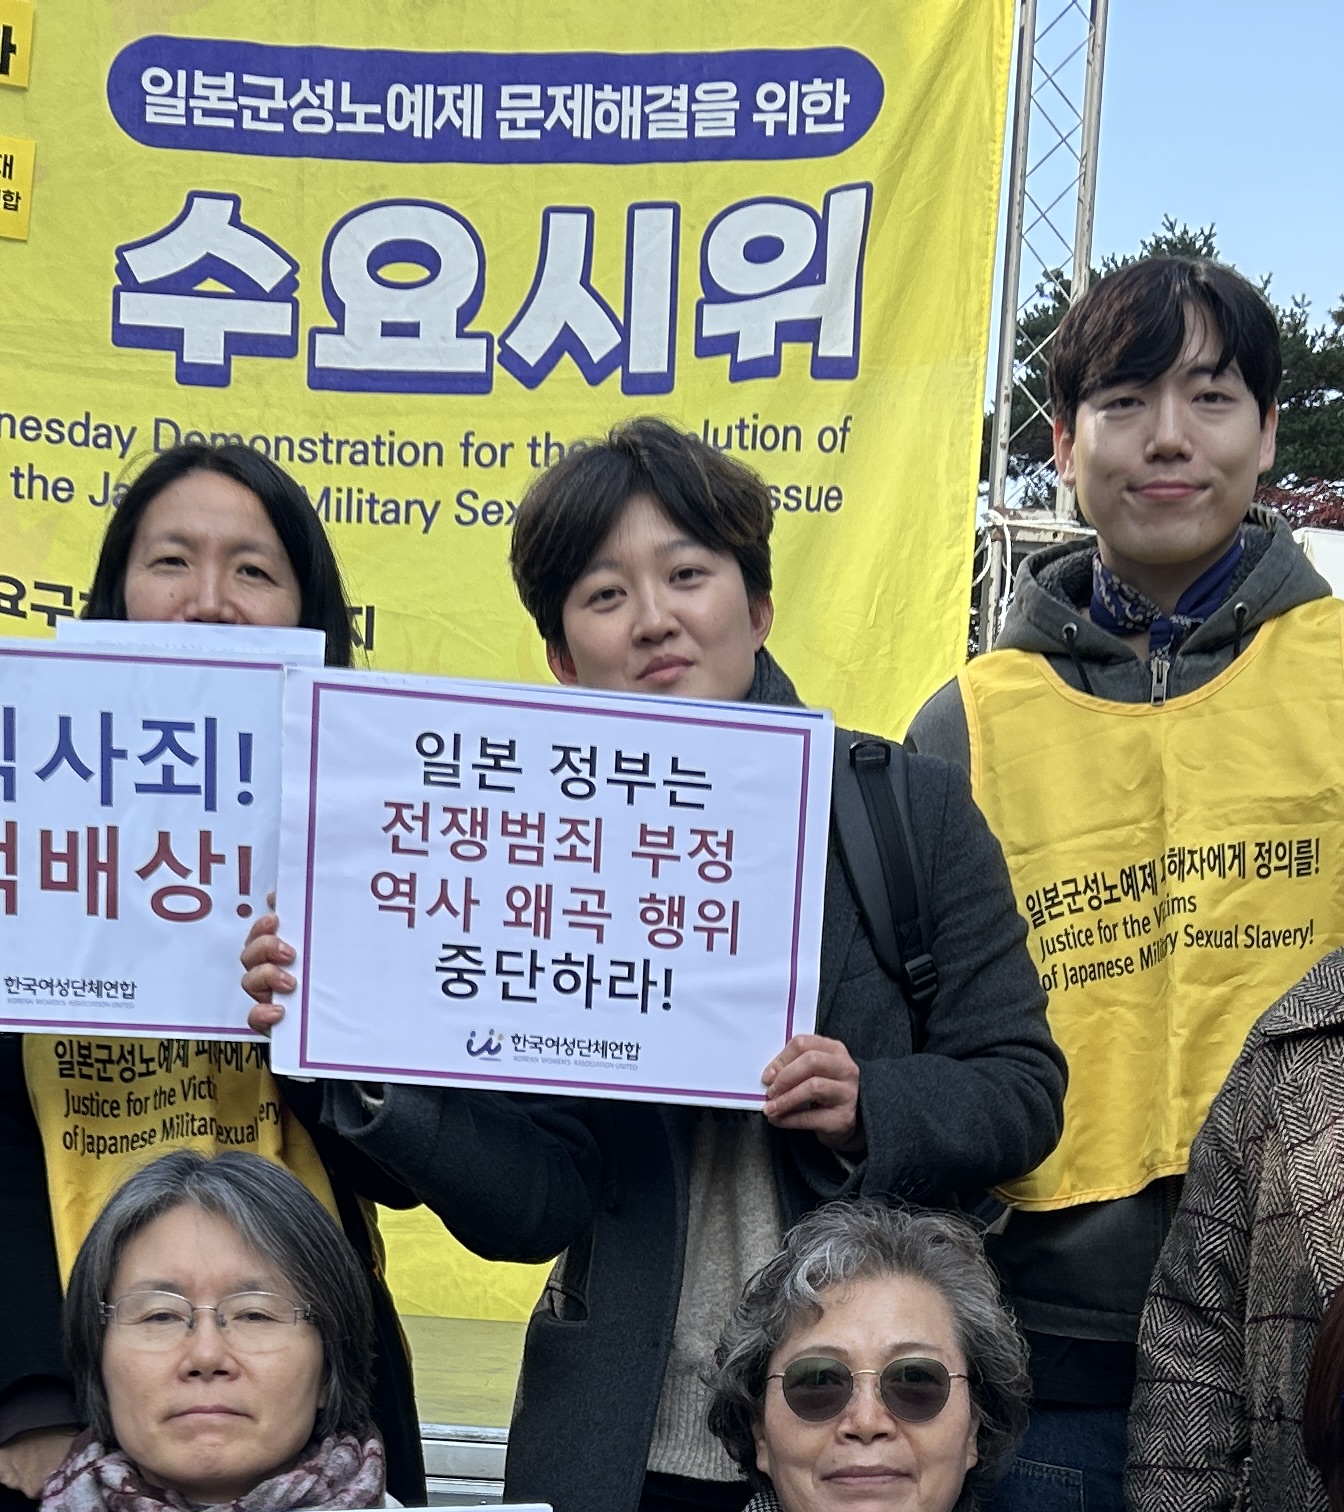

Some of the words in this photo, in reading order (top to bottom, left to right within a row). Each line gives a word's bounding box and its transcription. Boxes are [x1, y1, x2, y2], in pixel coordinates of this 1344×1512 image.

[140, 65, 483, 141] 일본군성노예제
[495, 79, 740, 141] 문제해결을
[752, 75, 850, 136] 위한
[112, 181, 873, 396] 수요시위
[460, 430, 514, 468] for
[817, 415, 852, 453] of
[11, 464, 76, 504] the
[770, 484, 843, 512] ssue
[415, 730, 523, 793] 일본
[550, 744, 713, 810] 정부는
[381, 800, 604, 874] 전쟁범죄
[631, 822, 735, 884] 부정
[370, 870, 480, 934] 역사
[502, 882, 612, 945] 왜곡
[638, 893, 741, 957] 행위
[1025, 860, 1157, 930] 일본군성노예제
[1253, 838, 1320, 879] 정의를!
[1039, 924, 1094, 963] Justice
[1097, 918, 1118, 946] for
[1122, 913, 1151, 940] the
[1041, 963, 1058, 992] of
[1063, 954, 1134, 992] Japanese
[1183, 924, 1239, 950] Sexual
[1244, 919, 1314, 950] Slavery!
[4, 976, 137, 1000] 한국여성단체연합
[435, 943, 673, 1015] 중단하라!
[54, 1039, 189, 1084] 일본군성노예제
[511, 1033, 641, 1061] 한국여성단체연합
[64, 1089, 121, 1118] Justice
[127, 1092, 150, 1117] for
[154, 1086, 176, 1112] the
[63, 1125, 79, 1151] of
[79, 1127, 157, 1160] Japanese
